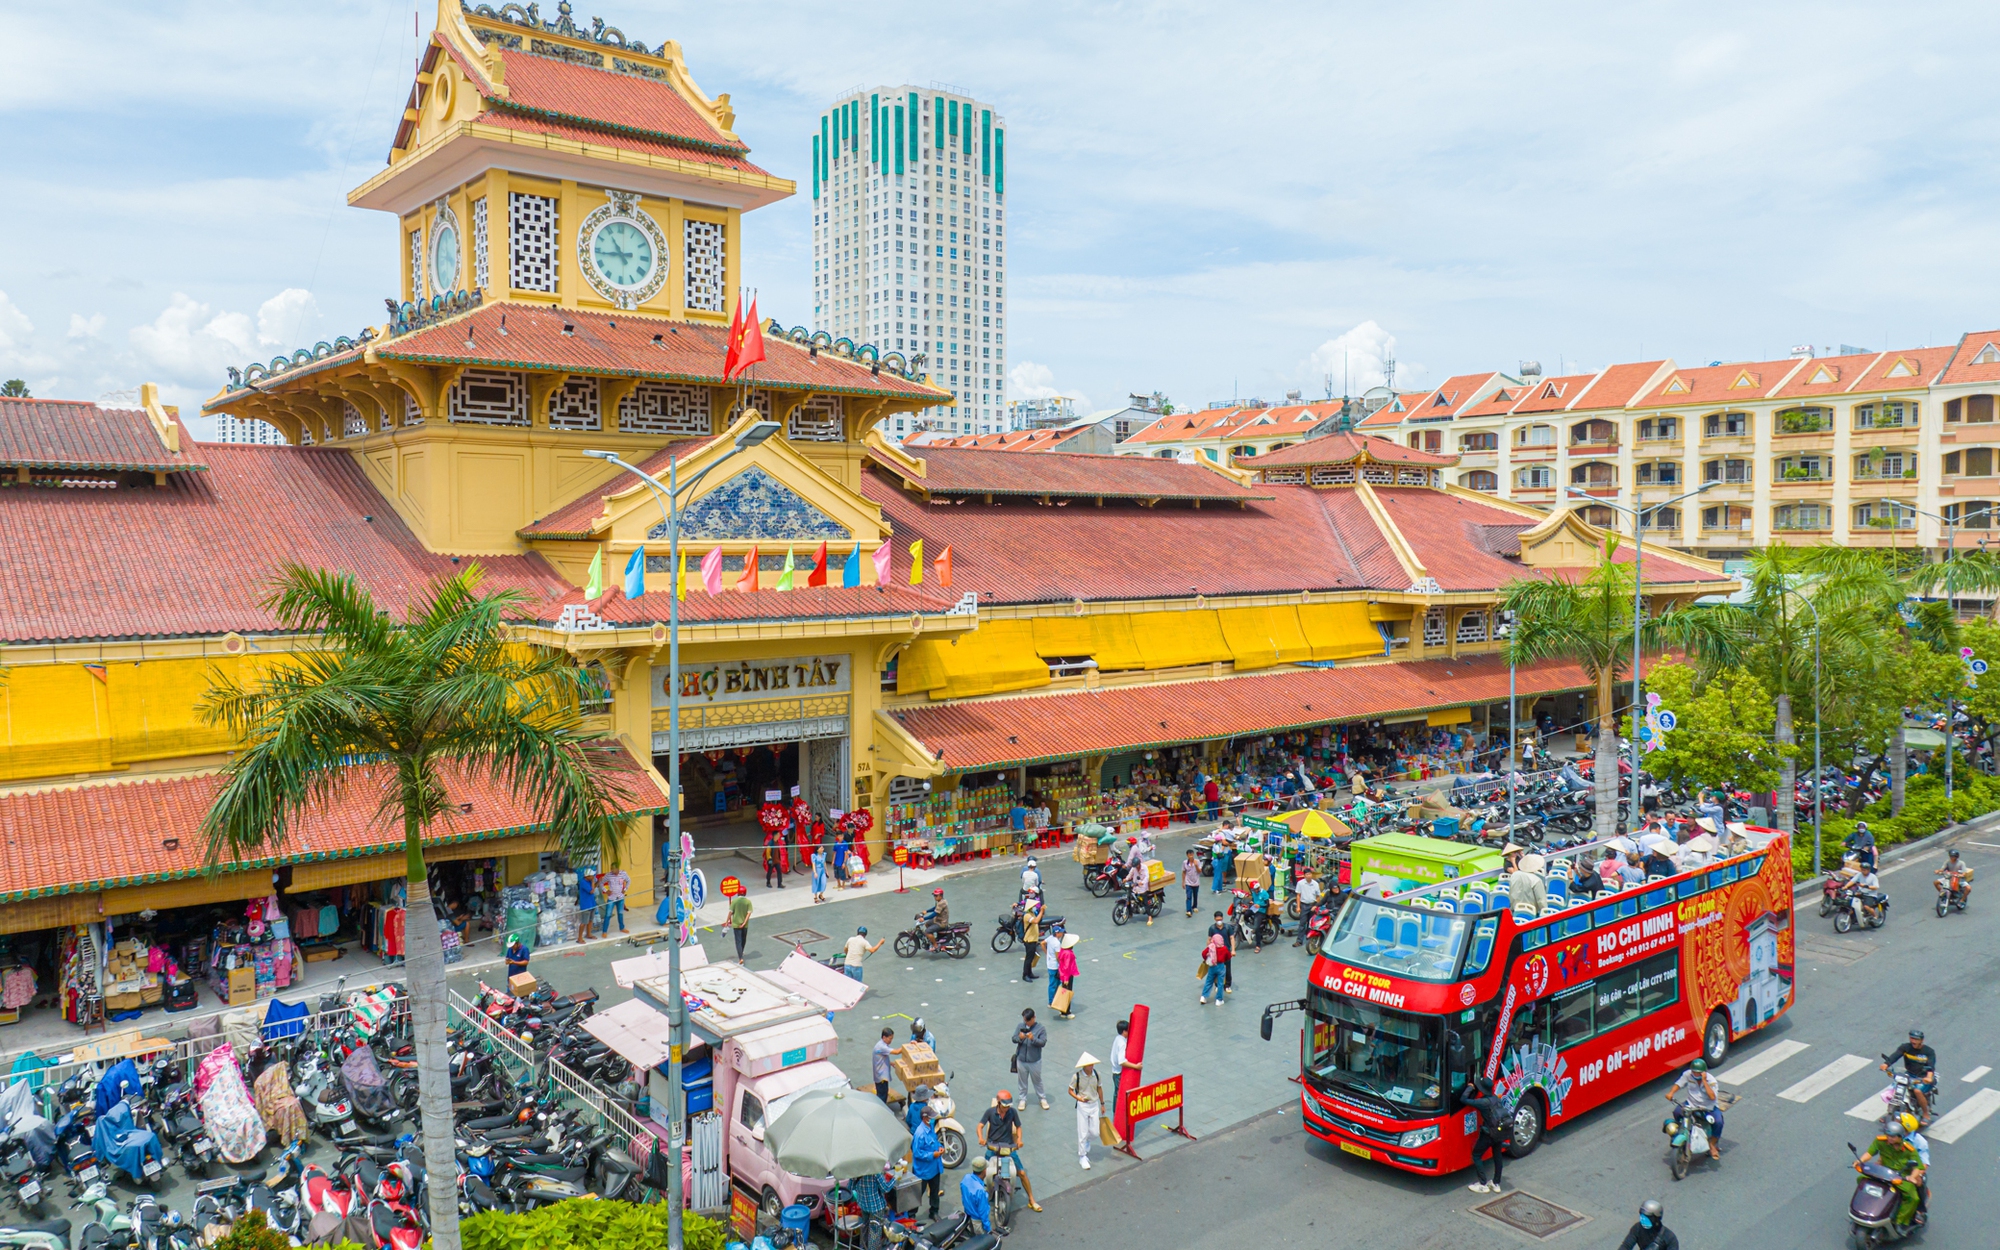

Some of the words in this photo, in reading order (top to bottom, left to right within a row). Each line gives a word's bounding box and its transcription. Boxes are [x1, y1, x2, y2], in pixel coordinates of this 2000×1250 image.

[724, 660, 790, 694] BÌNH
[793, 657, 841, 688] TÂY
[858, 762, 871, 772] 57A
[1677, 901, 1696, 921] CITY
[1698, 899, 1716, 915] TOUR
[1597, 932, 1617, 954] HO
[1619, 922, 1641, 946] CHI
[1642, 911, 1674, 938] MINH
[1626, 946, 1638, 958] +84
[1638, 941, 1650, 953] 913
[1650, 938, 1658, 949] 67
[1659, 935, 1667, 946] 44
[1667, 932, 1675, 943] 12
[1343, 967, 1366, 982] CITY
[1367, 975, 1391, 989] TOUR
[1650, 971, 1662, 986] CITY
[1663, 968, 1677, 981] TOUR
[1323, 975, 1342, 991] HO
[1344, 981, 1367, 998] CHI
[1368, 987, 1405, 1008] MINH
[1579, 1059, 1604, 1086] HOP
[1606, 1037, 1651, 1073] ON-HOP
[1654, 1026, 1685, 1052] OFF.VN
[1168, 1081, 1176, 1093] XE
[1130, 1092, 1151, 1117] CẤM
[1155, 1098, 1169, 1112] MUA
[1169, 1093, 1182, 1107] BÁN
